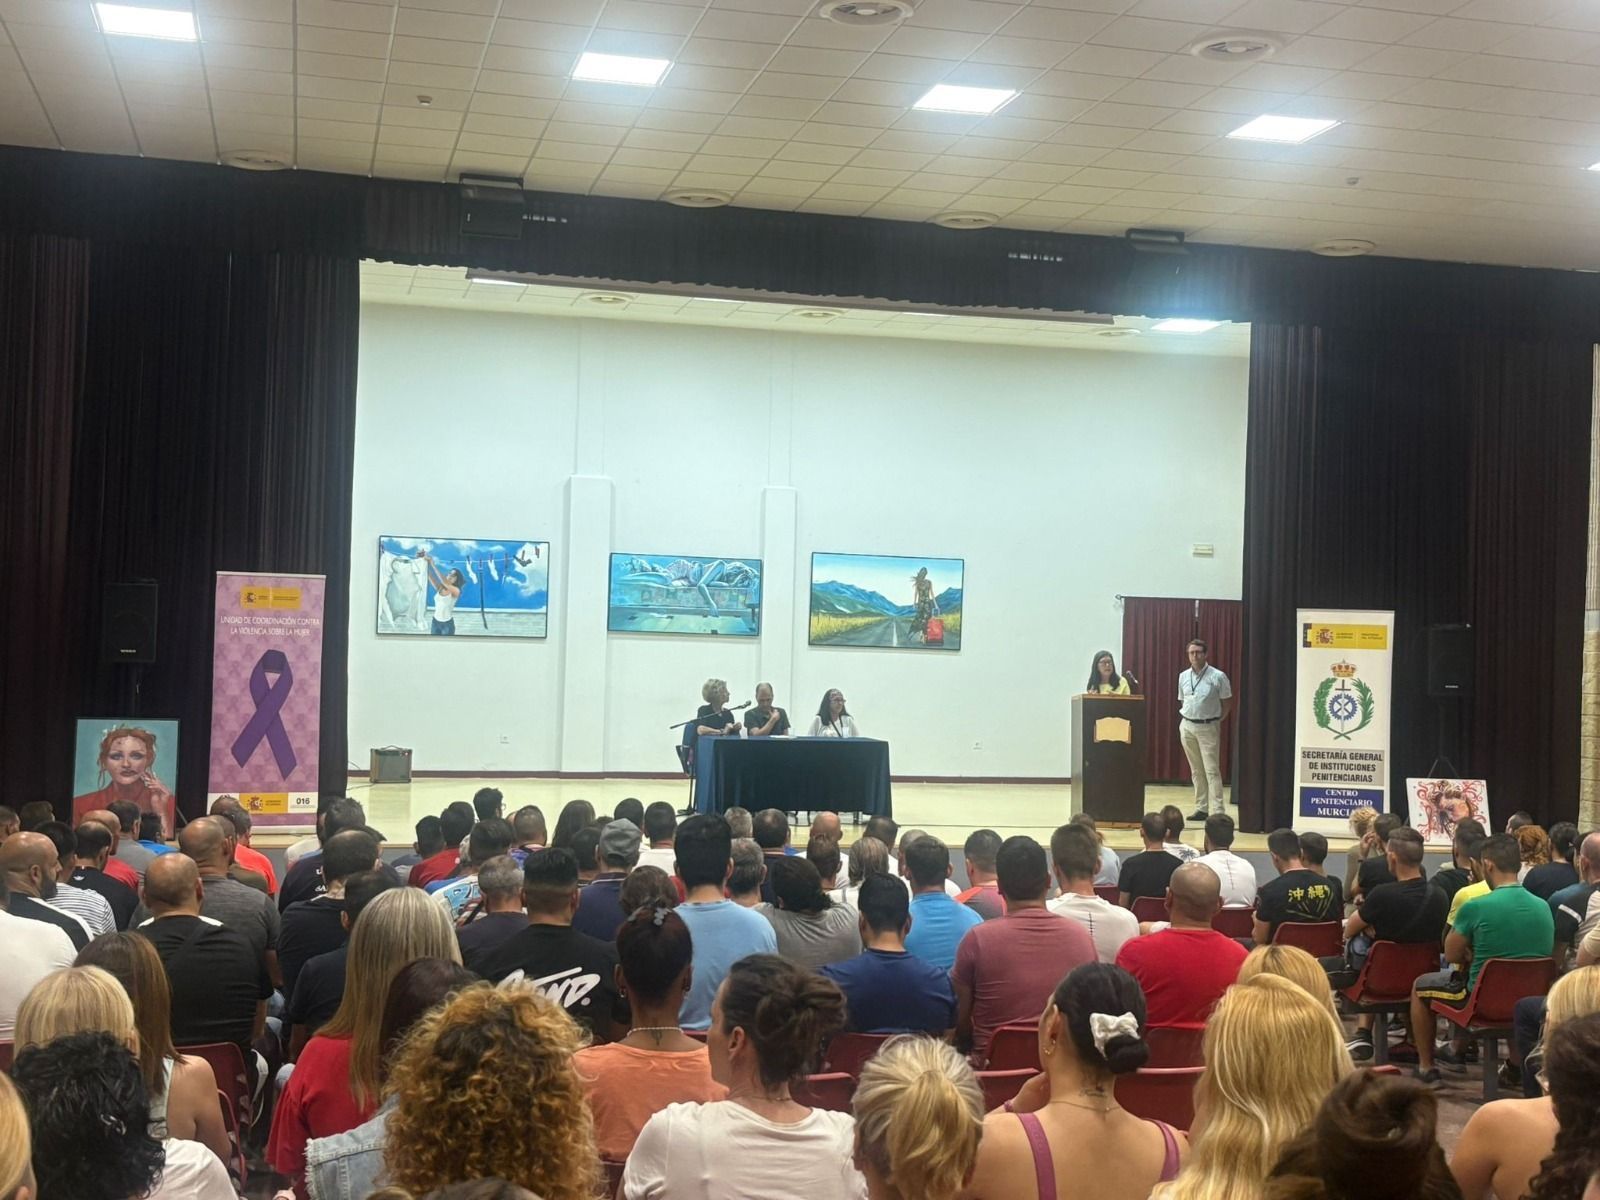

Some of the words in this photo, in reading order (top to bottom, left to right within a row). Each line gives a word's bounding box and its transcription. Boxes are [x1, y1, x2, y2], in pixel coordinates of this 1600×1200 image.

[1302, 750, 1347, 759] SECRETARÍA
[1349, 752, 1384, 761] GENERAL
[1308, 761, 1319, 770] DE
[1320, 762, 1376, 772] INSTITUCIONES
[1312, 773, 1373, 782] PENITENCIARIAS
[1325, 789, 1359, 797] CENTRO
[296, 797, 310, 805] 016
[1310, 797, 1373, 807] PENITENCIARIO
